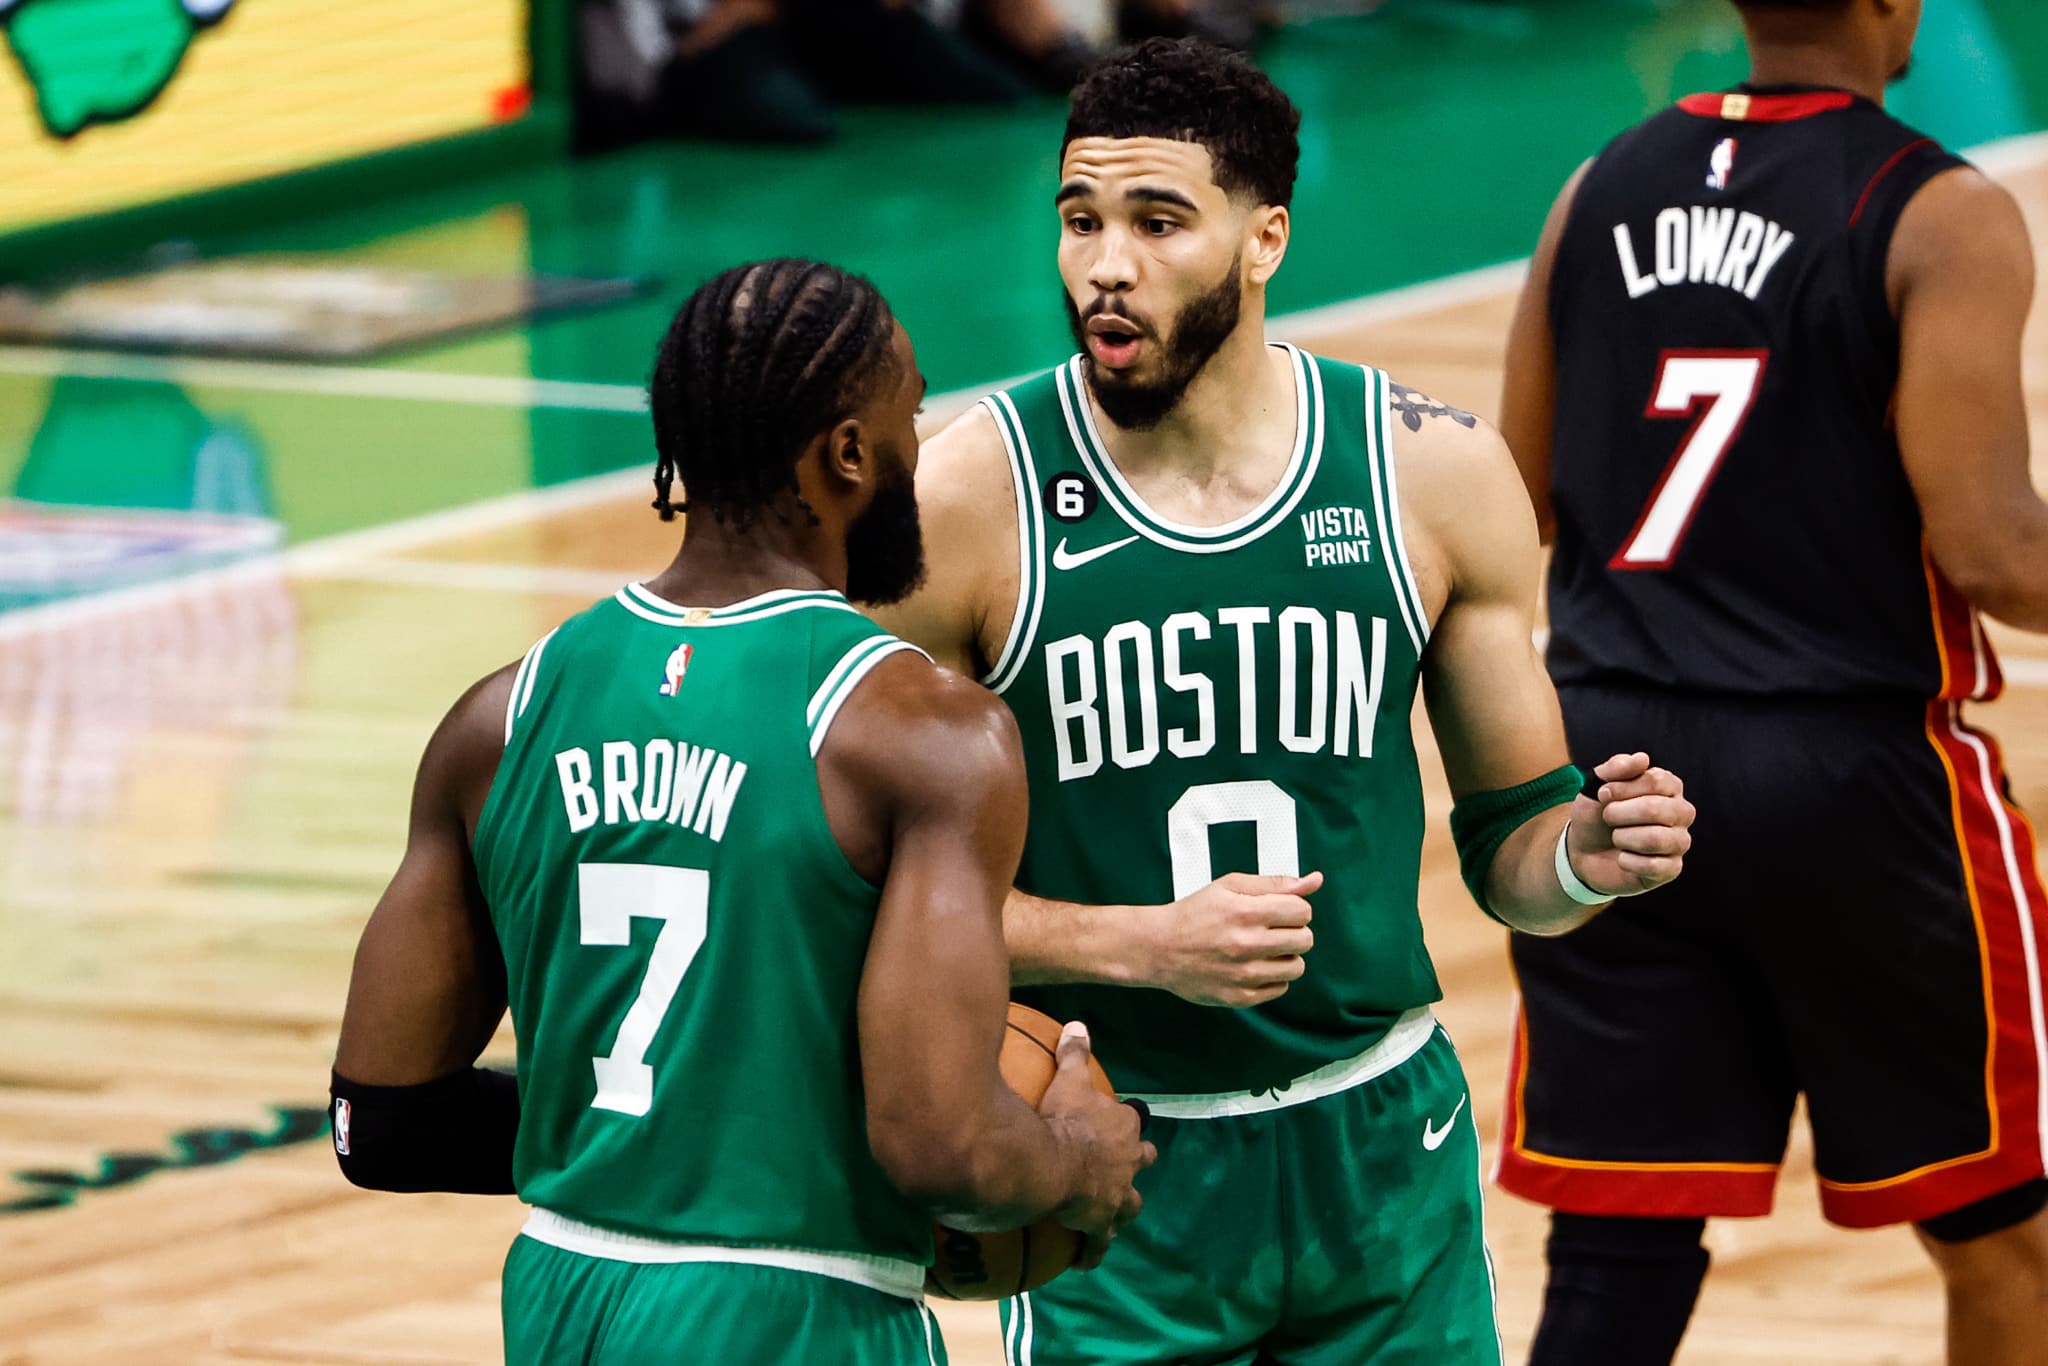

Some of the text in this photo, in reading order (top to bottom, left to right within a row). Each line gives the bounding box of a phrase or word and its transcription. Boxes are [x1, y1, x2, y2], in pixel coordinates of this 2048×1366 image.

[1613, 205, 1794, 300] LOWRY
[1056, 479, 1085, 517] 6
[1606, 347, 1770, 571] 7
[1300, 506, 1370, 541] VISTA
[1304, 540, 1371, 567] PRINT
[1044, 605, 1388, 782] BOSTON
[554, 738, 748, 842] BROWN
[577, 862, 710, 1117] 7
